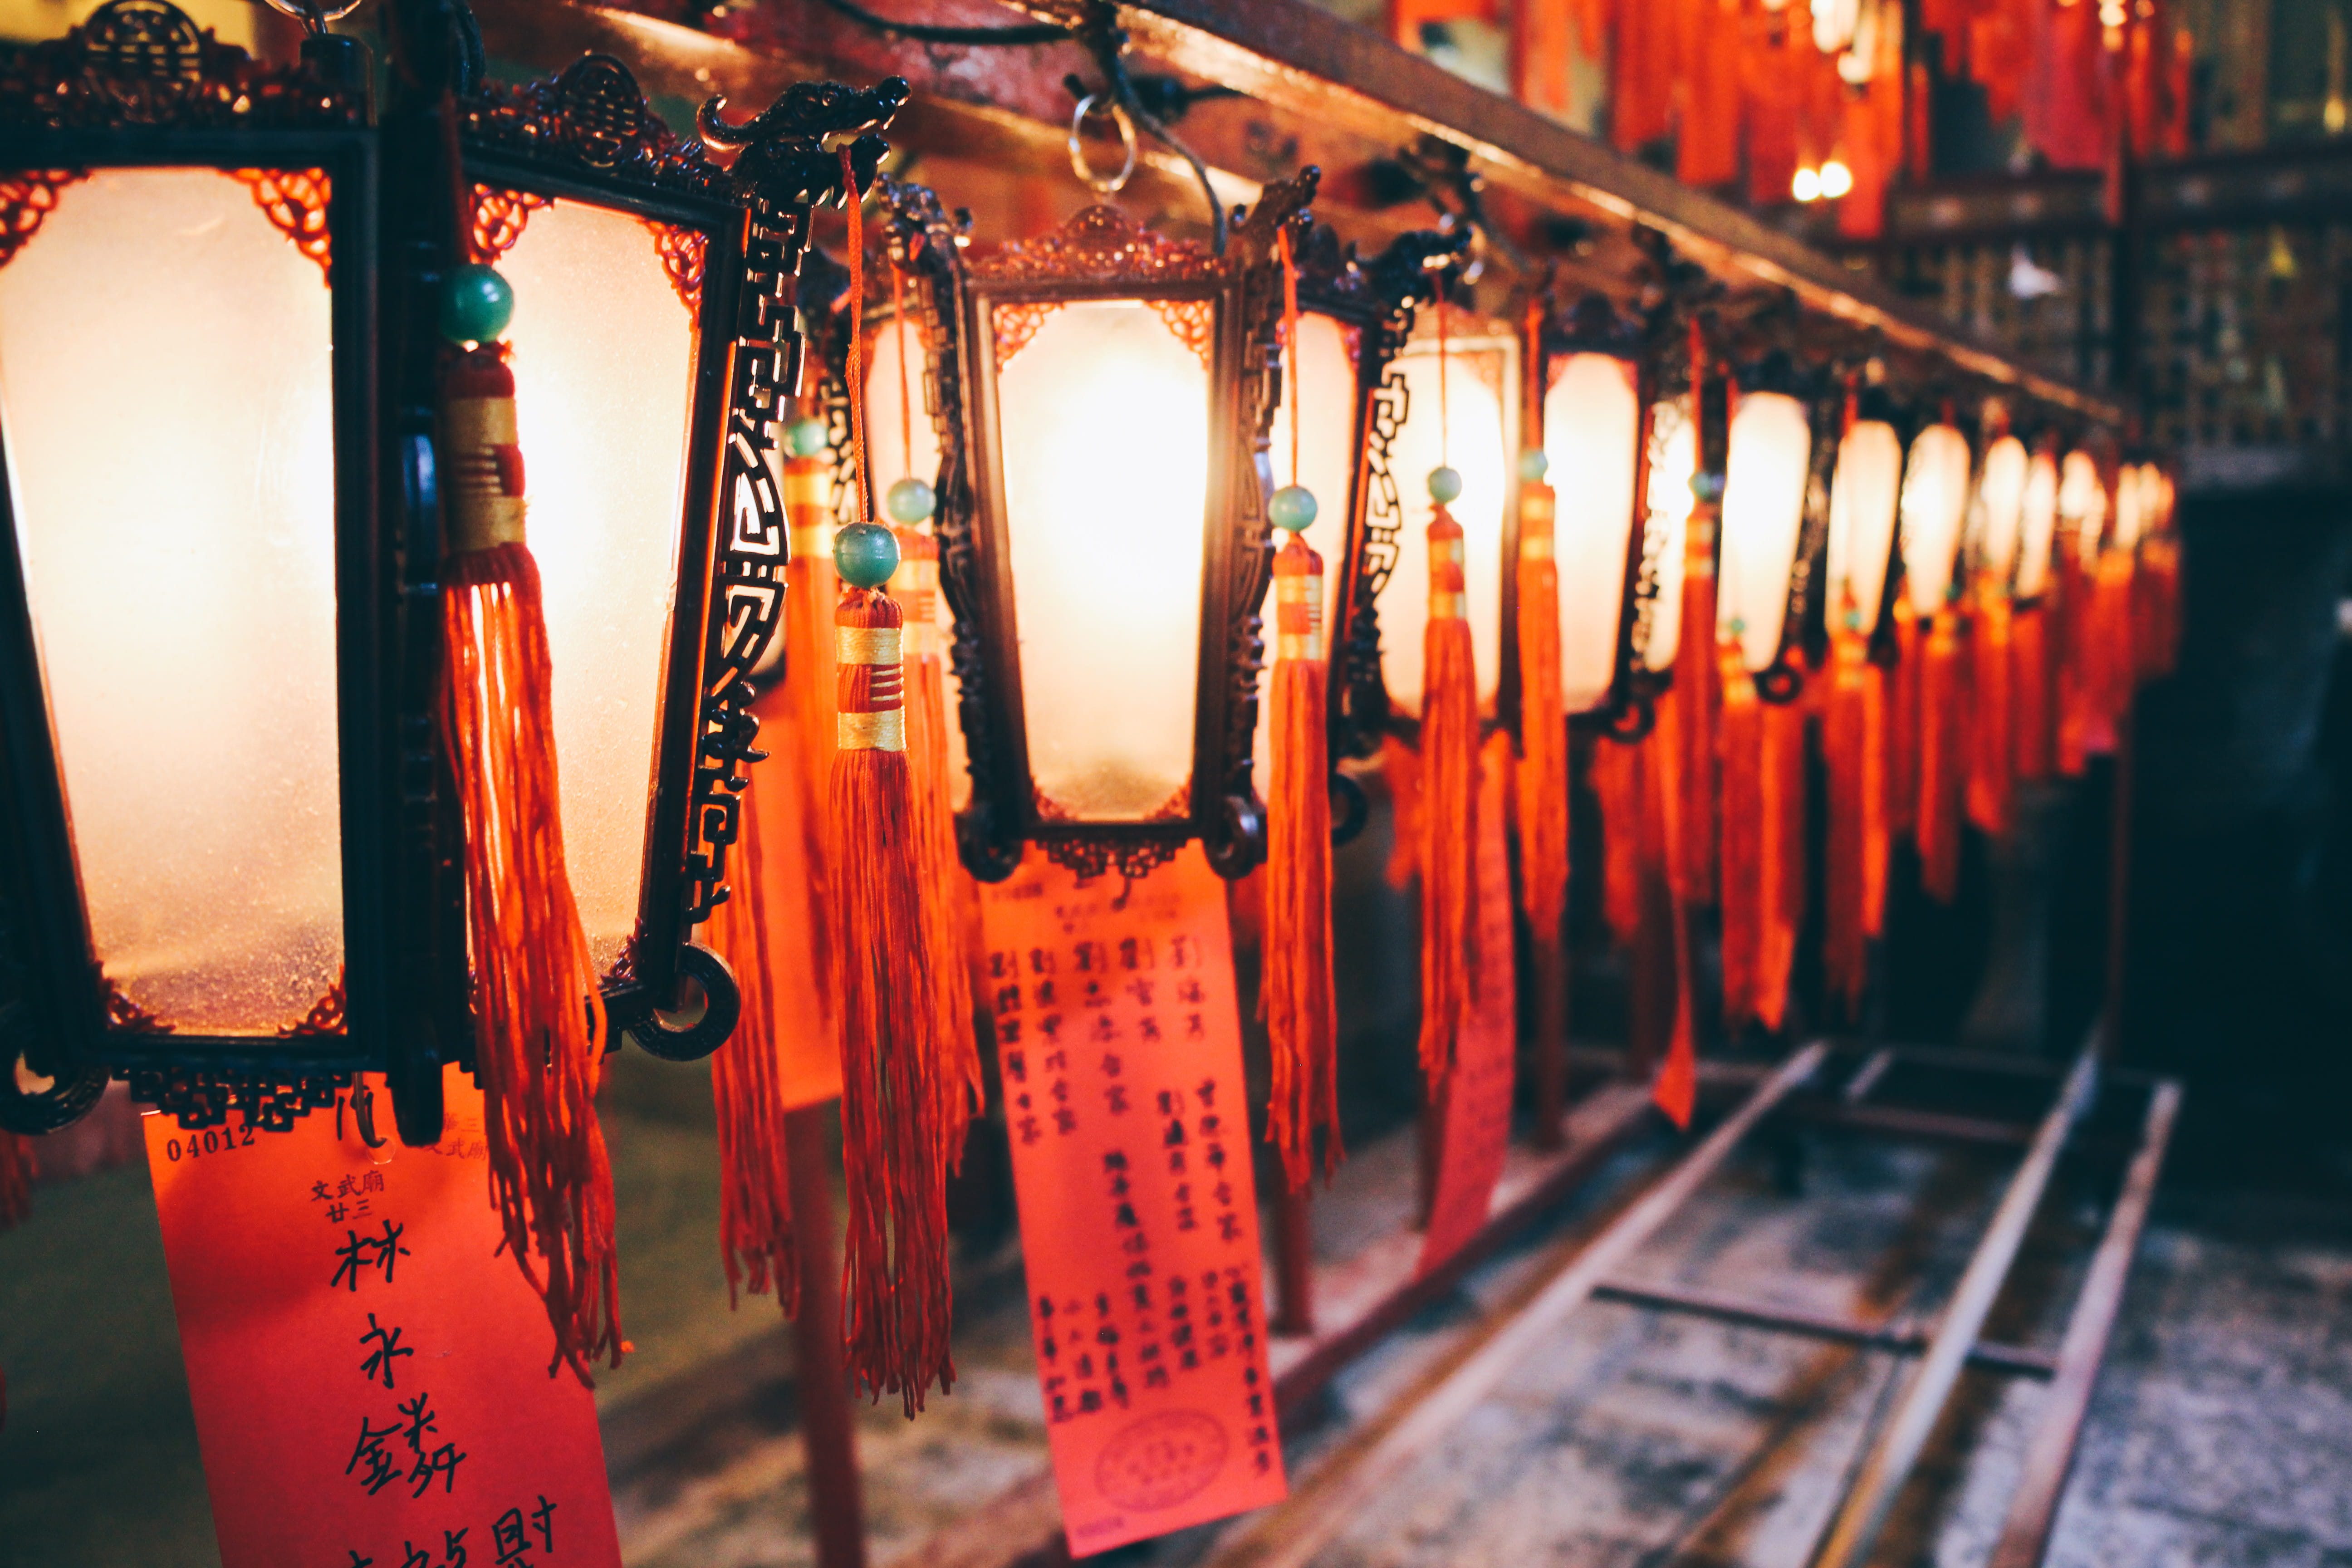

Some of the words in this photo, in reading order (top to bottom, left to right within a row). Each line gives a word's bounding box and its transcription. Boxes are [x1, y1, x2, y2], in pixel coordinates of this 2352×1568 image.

[167, 1123, 255, 1162] 04012
[311, 1170, 384, 1202] 文武廟
[325, 1202, 372, 1224] 廿三
